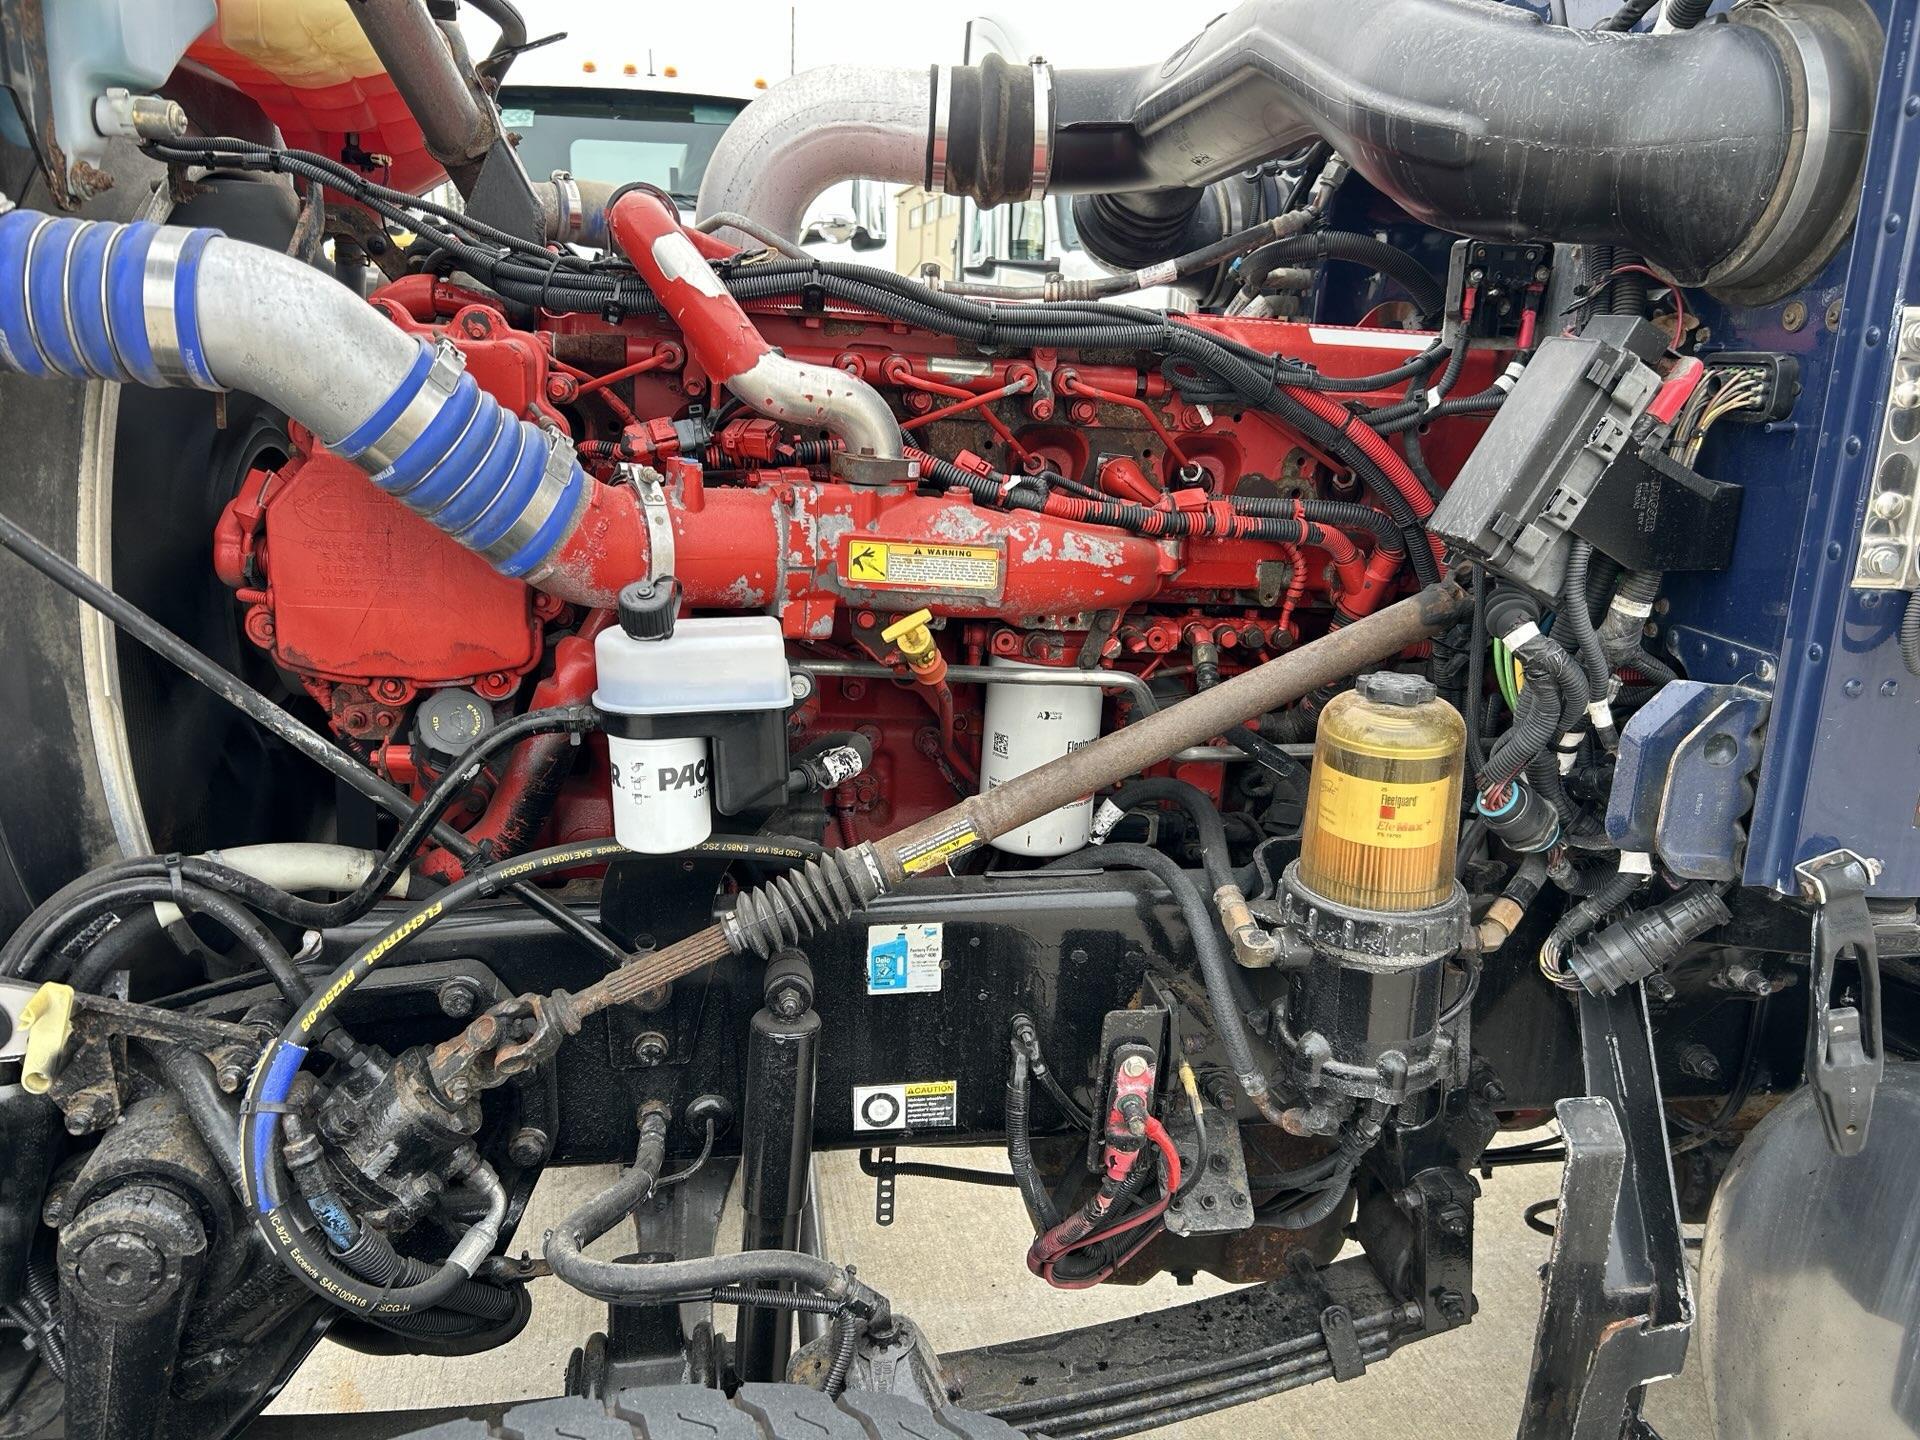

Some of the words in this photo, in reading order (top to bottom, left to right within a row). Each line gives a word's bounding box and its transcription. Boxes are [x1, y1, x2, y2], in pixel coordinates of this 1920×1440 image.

[927, 548, 972, 557] WARNING
[432, 716, 440, 731] OIL
[466, 704, 481, 736] ENGINE
[657, 758, 708, 792] PAC
[1380, 793, 1418, 809] Fleetguard
[596, 844, 632, 856] Exceeds
[702, 842, 720, 851] 2SC
[754, 846, 768, 854] WP
[770, 847, 784, 855] PSI
[542, 849, 593, 867] SAE100R16
[499, 861, 536, 879] USCG-H
[875, 956, 891, 964] Delo
[301, 969, 356, 1033] PX250-08
[914, 1085, 954, 1094] CAUTION
[289, 1247, 319, 1279] Exceeds
[319, 1276, 368, 1308] SAE100R16
[377, 1303, 411, 1313] SCG-H
